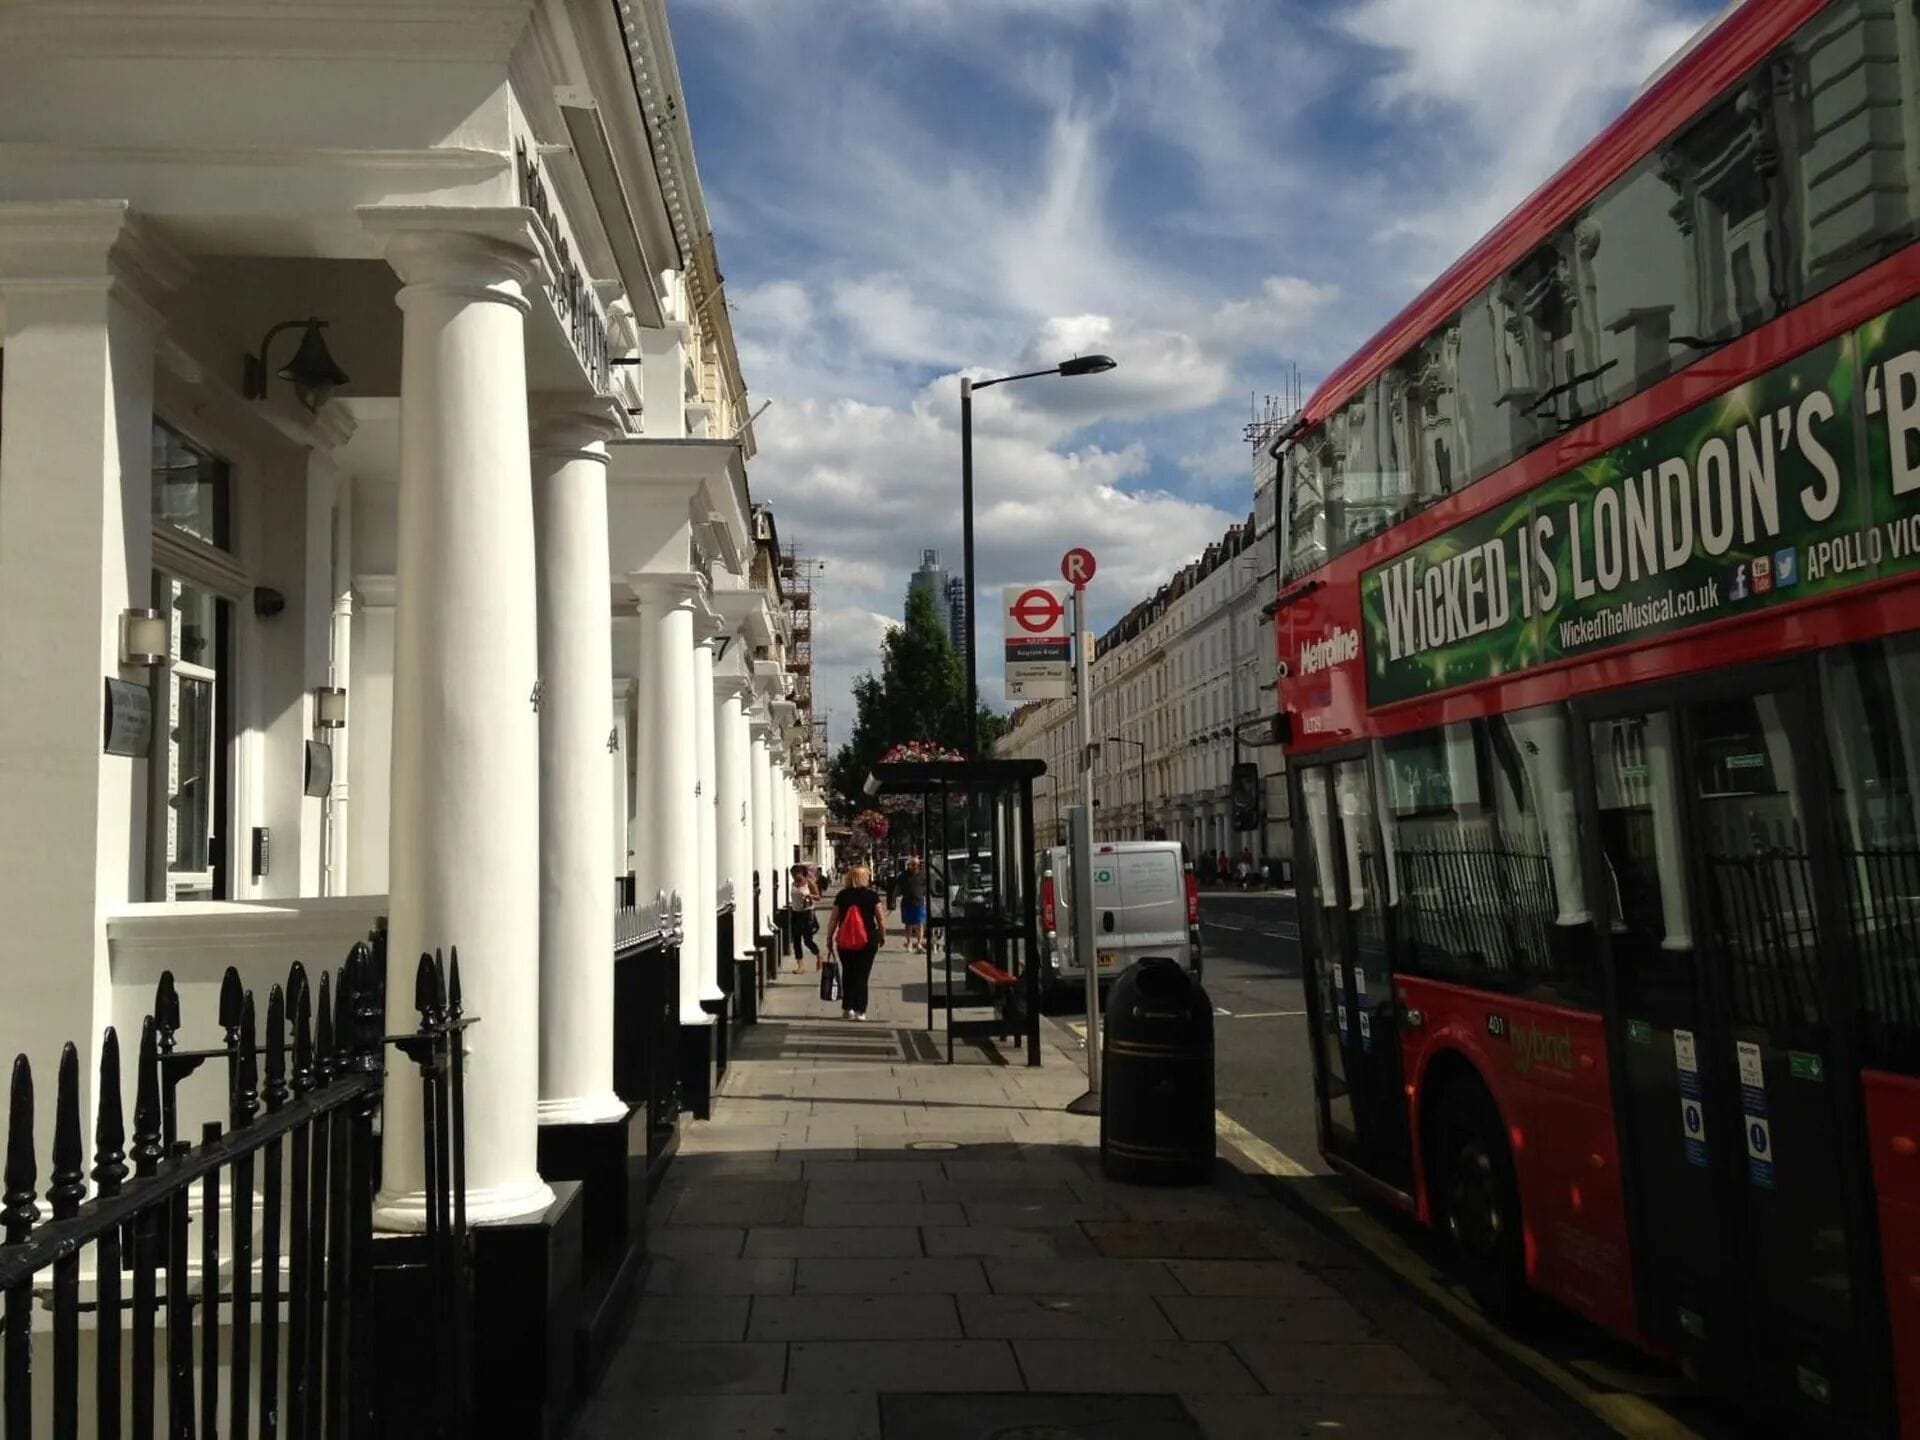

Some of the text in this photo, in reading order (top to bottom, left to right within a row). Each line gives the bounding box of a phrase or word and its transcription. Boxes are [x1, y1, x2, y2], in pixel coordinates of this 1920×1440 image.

[1518, 515, 1558, 619] IS
[1568, 390, 1841, 601] LONDON'S
[1069, 555, 1088, 579] R
[1806, 526, 1883, 582] APOLLO
[1559, 577, 1720, 649] WickedTheMusical.co.uk
[1300, 626, 1359, 677] Metroline
[1488, 1015, 1504, 1035] 401
[1508, 1017, 1572, 1073] hybrid
